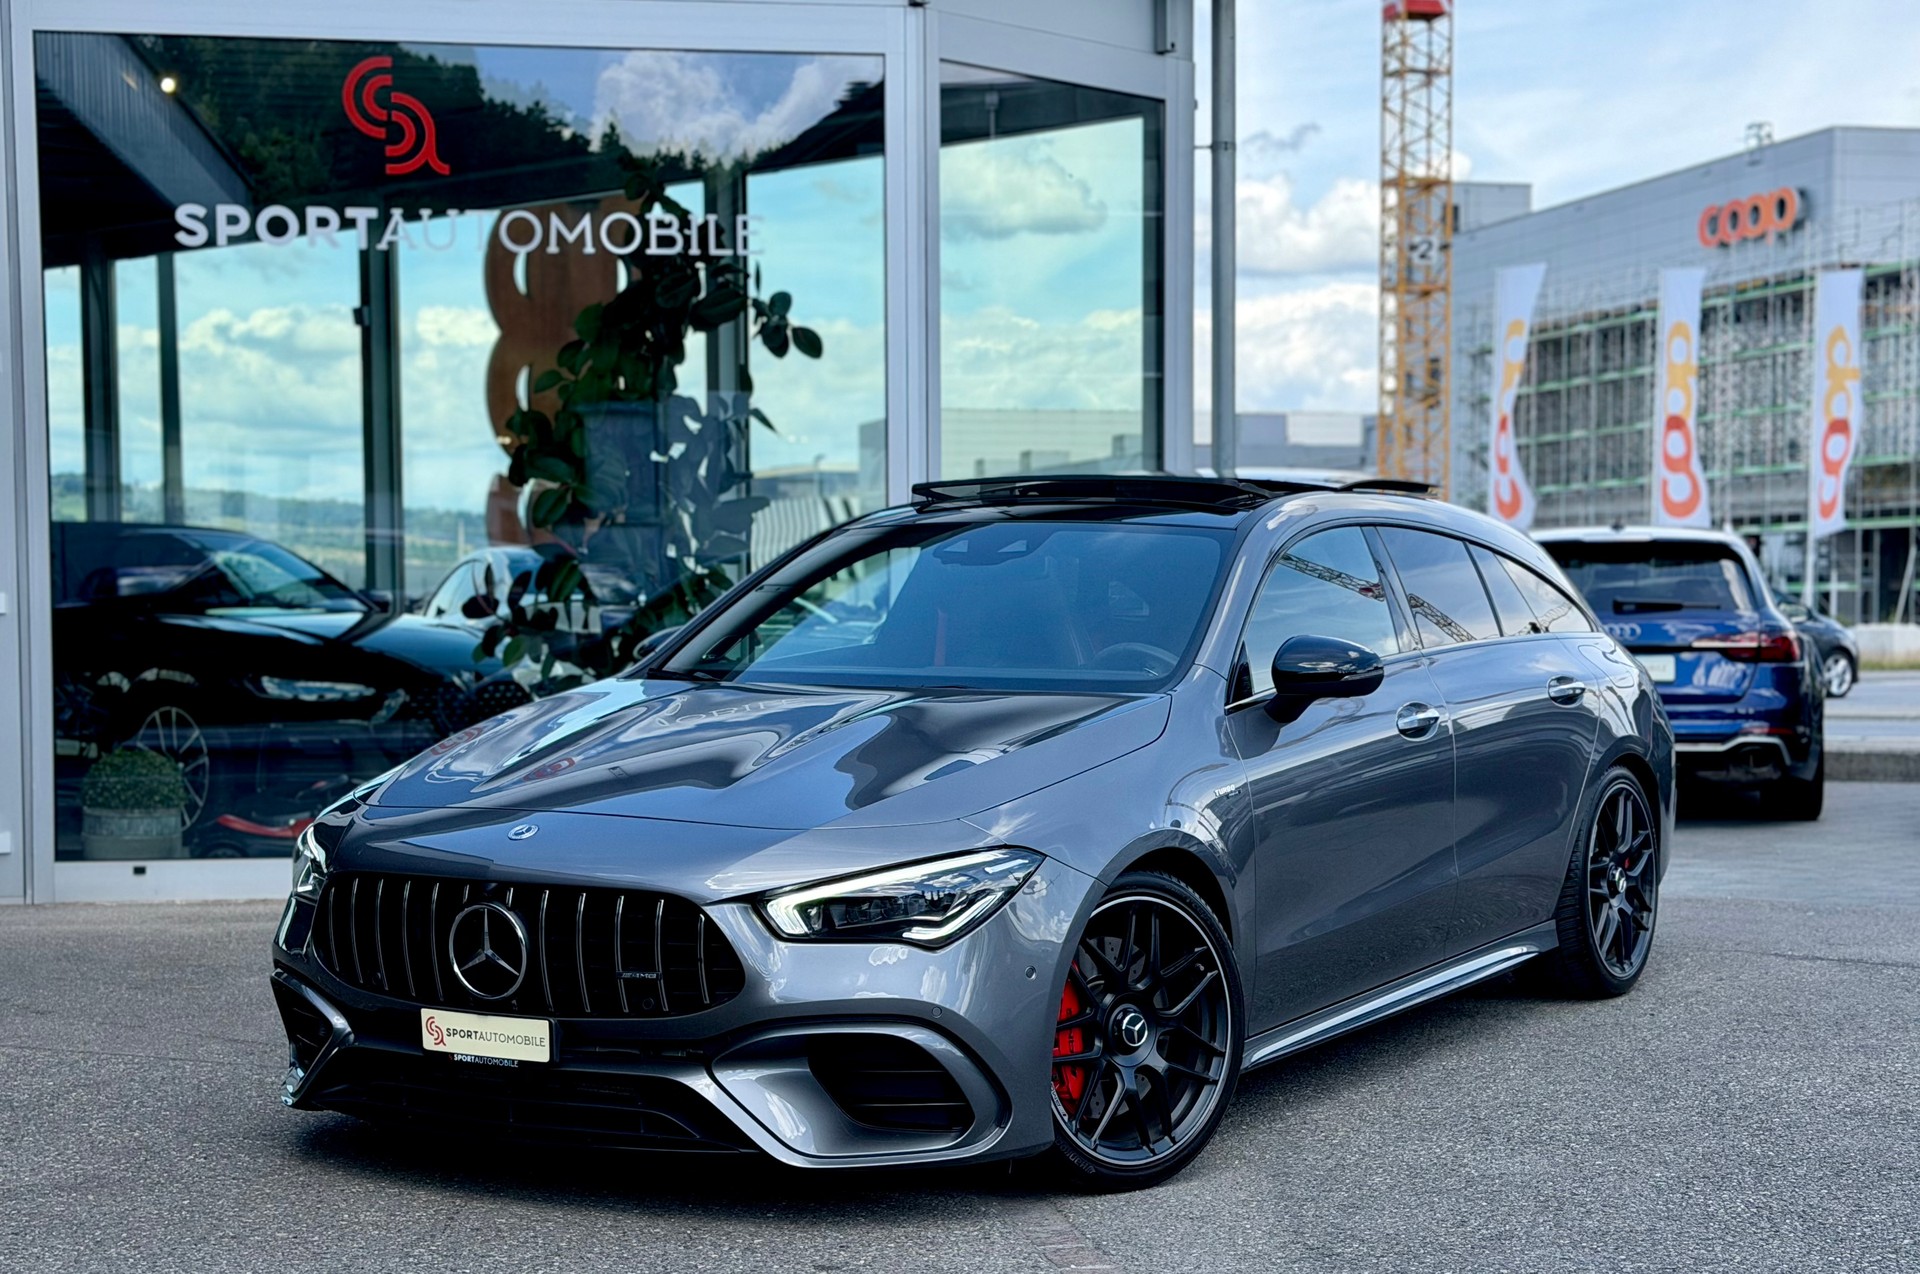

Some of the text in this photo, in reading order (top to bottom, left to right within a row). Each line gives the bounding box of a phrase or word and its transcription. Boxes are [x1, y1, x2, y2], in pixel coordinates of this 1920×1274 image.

[174, 203, 764, 257] SPORTAUTOMOBILE
[1698, 186, 1797, 248] coop
[1661, 321, 1702, 520] coop
[446, 1027, 546, 1047] SPORTAUTOMOBILE
[453, 1053, 519, 1068] SPORTAUTOMOBILE
